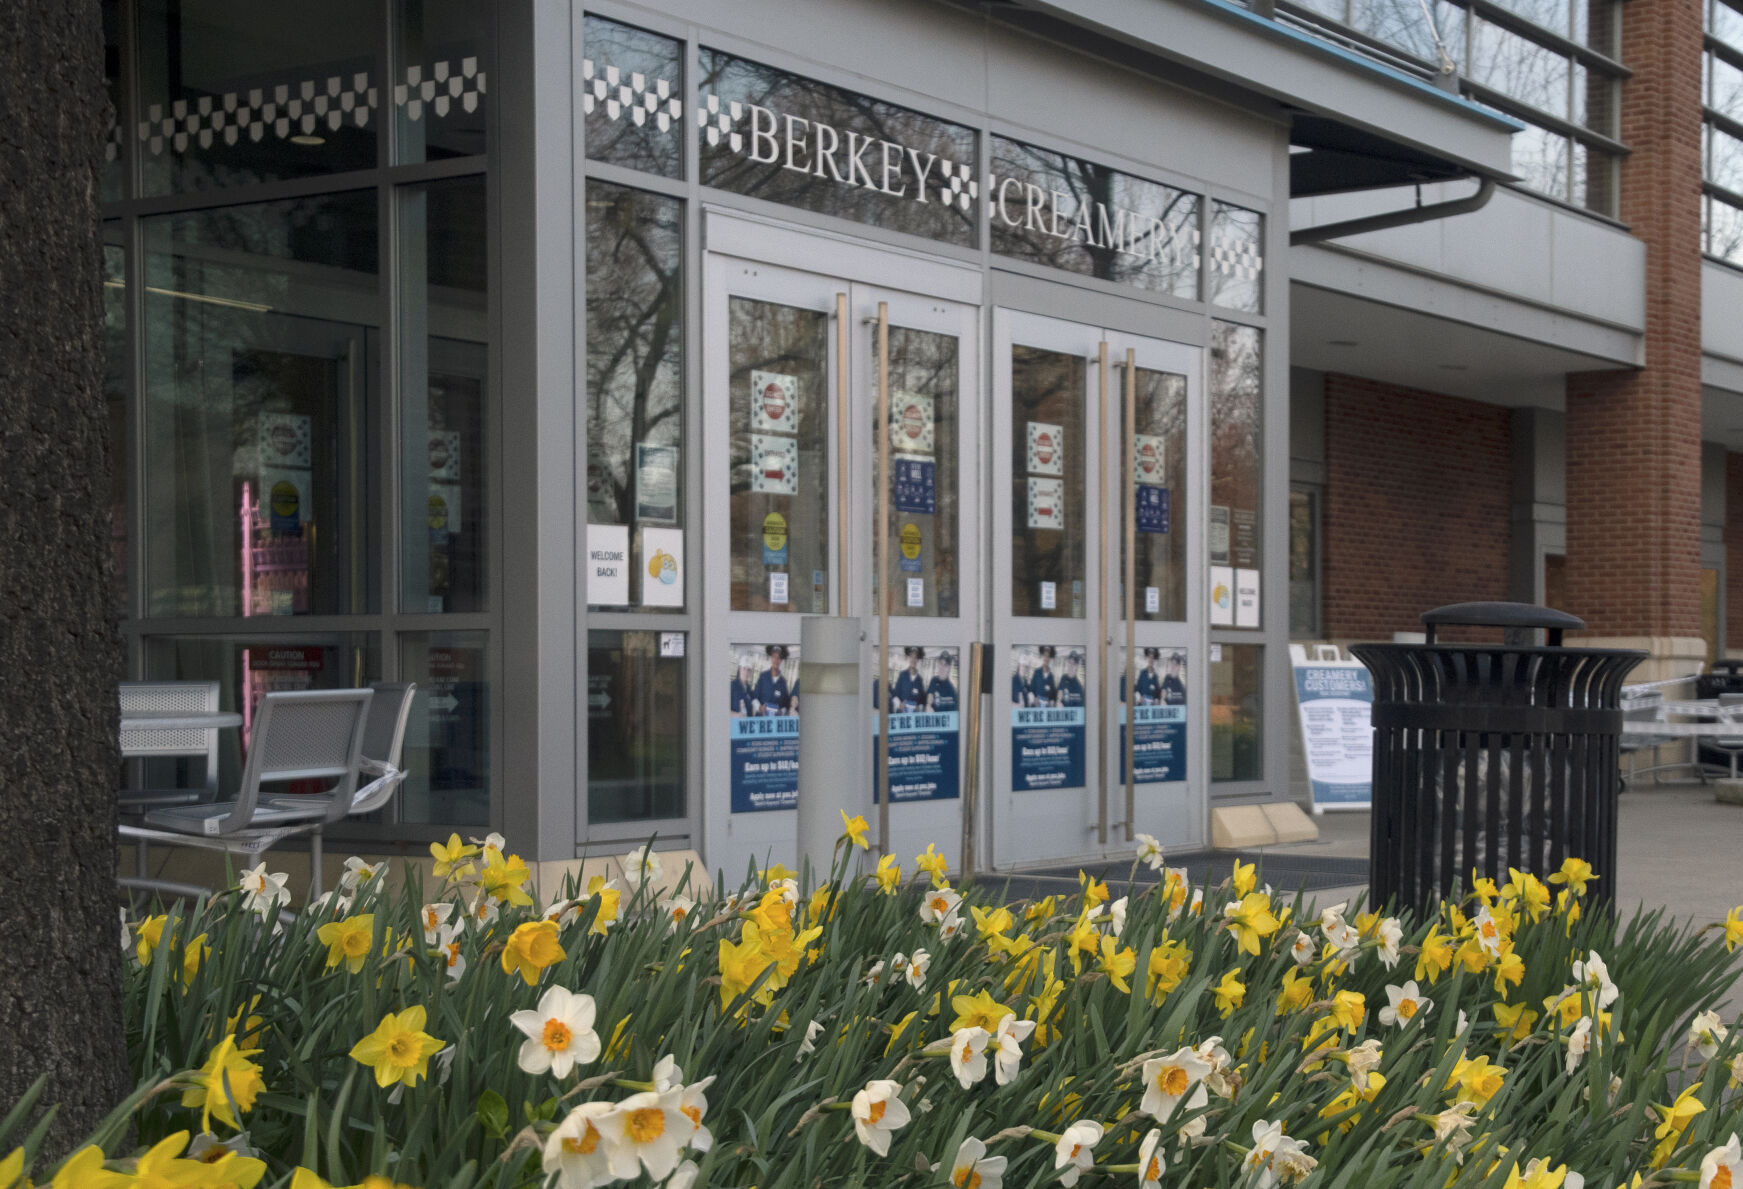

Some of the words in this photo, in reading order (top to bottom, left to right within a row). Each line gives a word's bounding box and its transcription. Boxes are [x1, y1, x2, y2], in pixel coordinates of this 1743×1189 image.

[748, 103, 938, 204] BERKEY
[1000, 177, 1189, 266] CREAMERY
[590, 550, 624, 561] WELCOME
[597, 567, 618, 577] BACK!
[268, 650, 305, 659] CAUTION
[1306, 669, 1358, 680] CREAMERY
[738, 719, 773, 734] WE'RE
[914, 714, 950, 728] HIRING!
